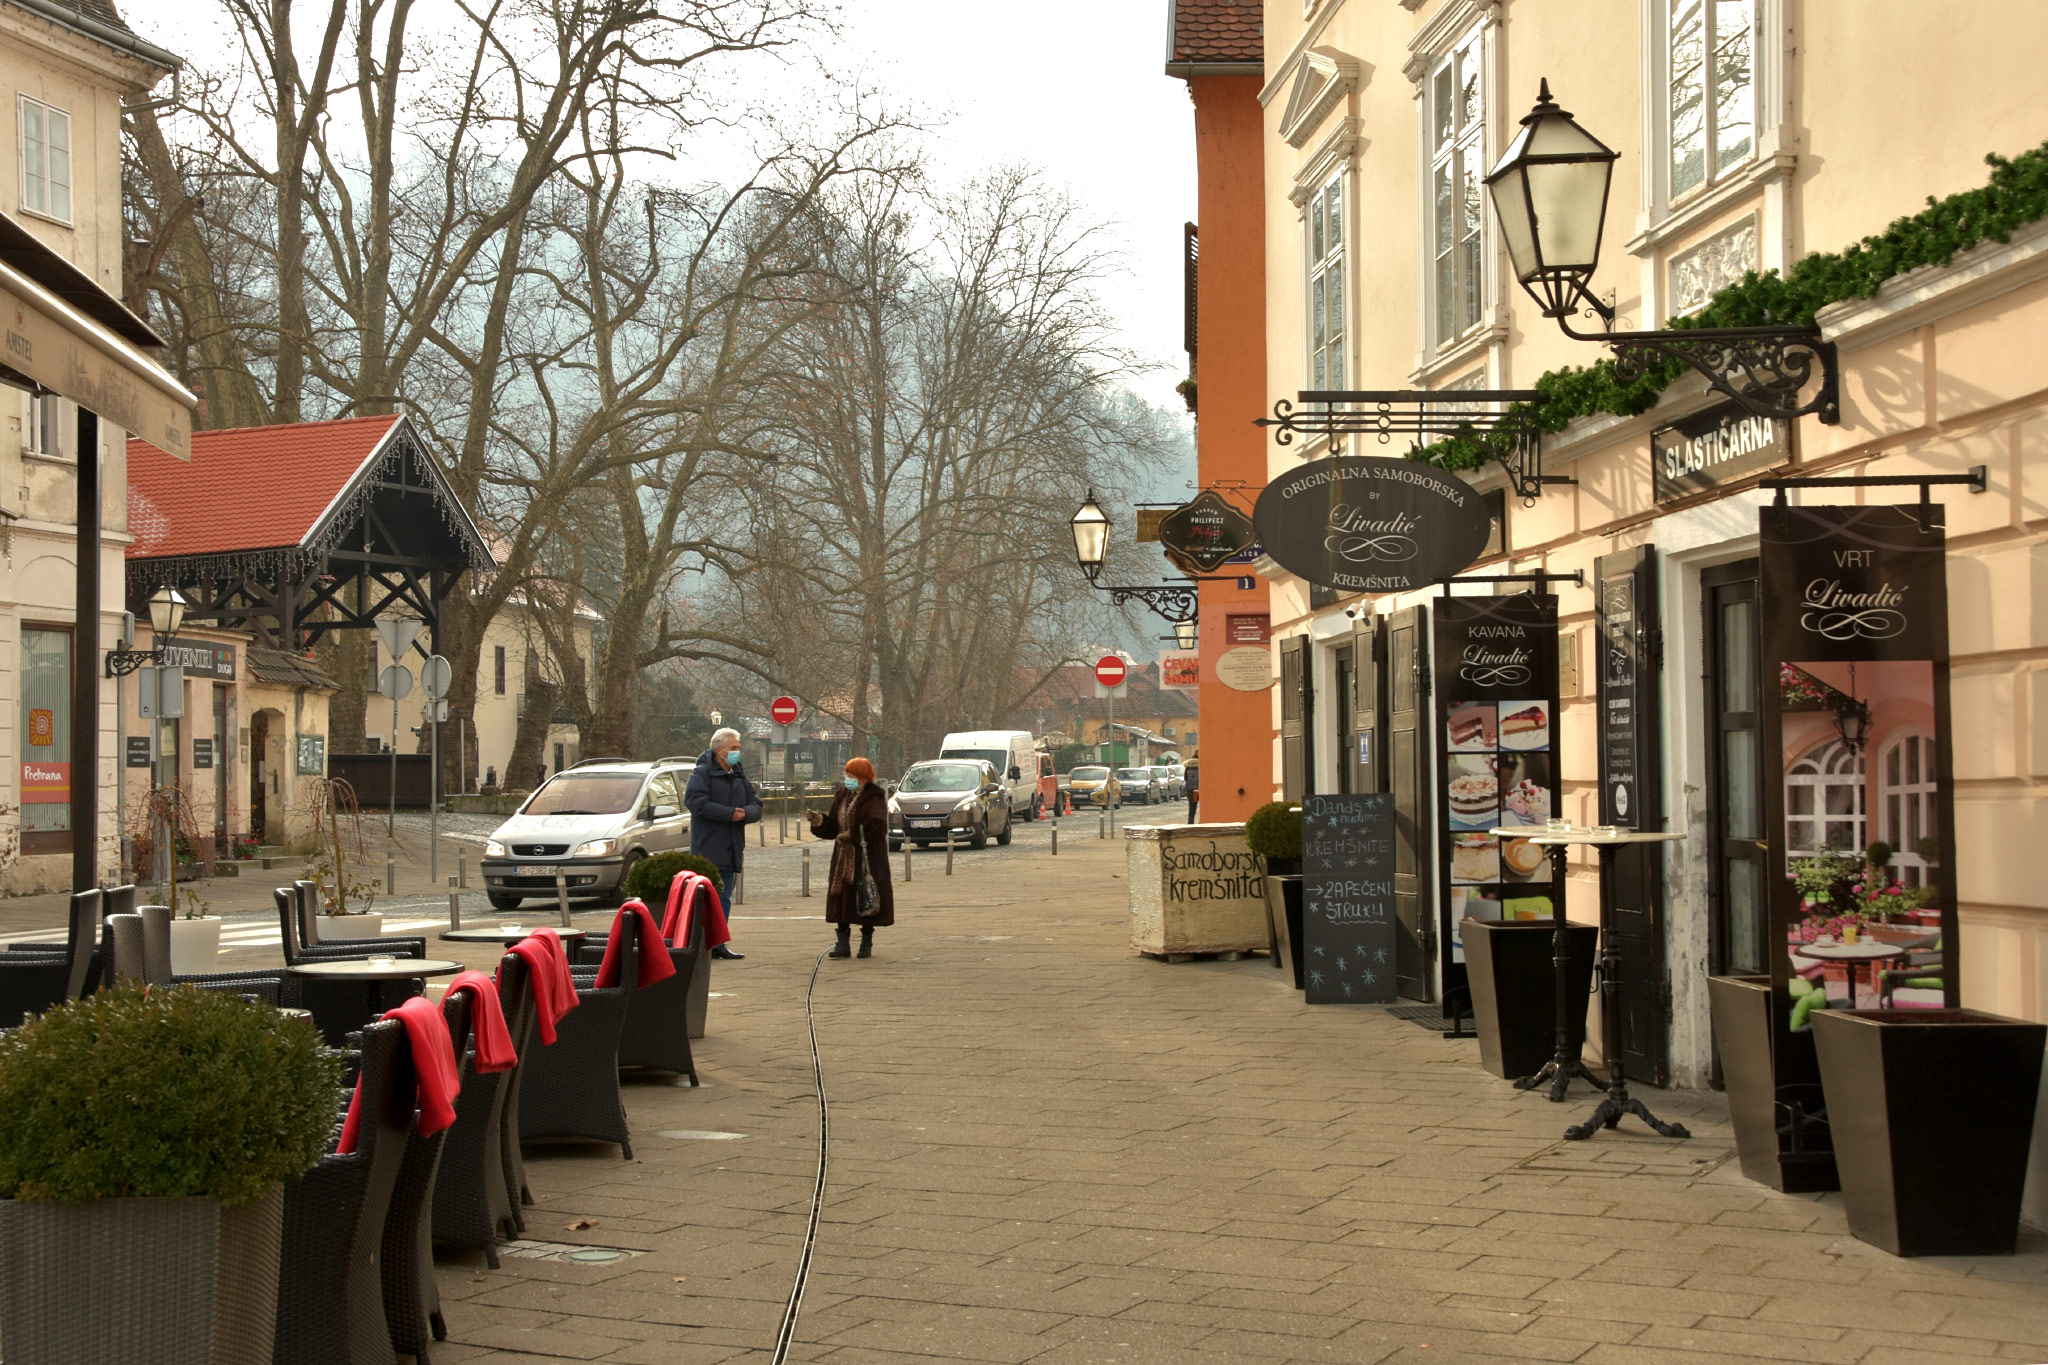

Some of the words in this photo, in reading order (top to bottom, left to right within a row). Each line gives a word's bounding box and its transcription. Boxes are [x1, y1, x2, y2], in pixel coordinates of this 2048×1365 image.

[5, 327, 32, 362] AMSTEL
[1666, 415, 1774, 480] SLASTIČARNA
[1282, 467, 1370, 501] ORIGINALNA
[1373, 467, 1465, 508] SAMOBORSKA
[1369, 491, 1381, 501] BY
[1324, 503, 1422, 535] Livadić
[1833, 550, 1875, 568] VRT
[1243, 578, 1249, 589] 1
[1332, 572, 1411, 589] KREMŠNITA
[1801, 577, 1910, 609] Livadić
[1468, 625, 1526, 638] KAVANA
[157, 644, 213, 669] SUVENIRI
[1460, 643, 1534, 666] Livadić
[1164, 673, 1199, 686] SOMU
[24, 765, 63, 781] Prehrana
[1312, 797, 1363, 817] Danas
[1162, 840, 1263, 872] Samoborsk
[1306, 838, 1389, 858] KREMŠNITE
[1170, 872, 1265, 902] kremšnita
[1324, 879, 1391, 899] ZAPEČENI
[1326, 901, 1383, 920] ŠTRUKLI
